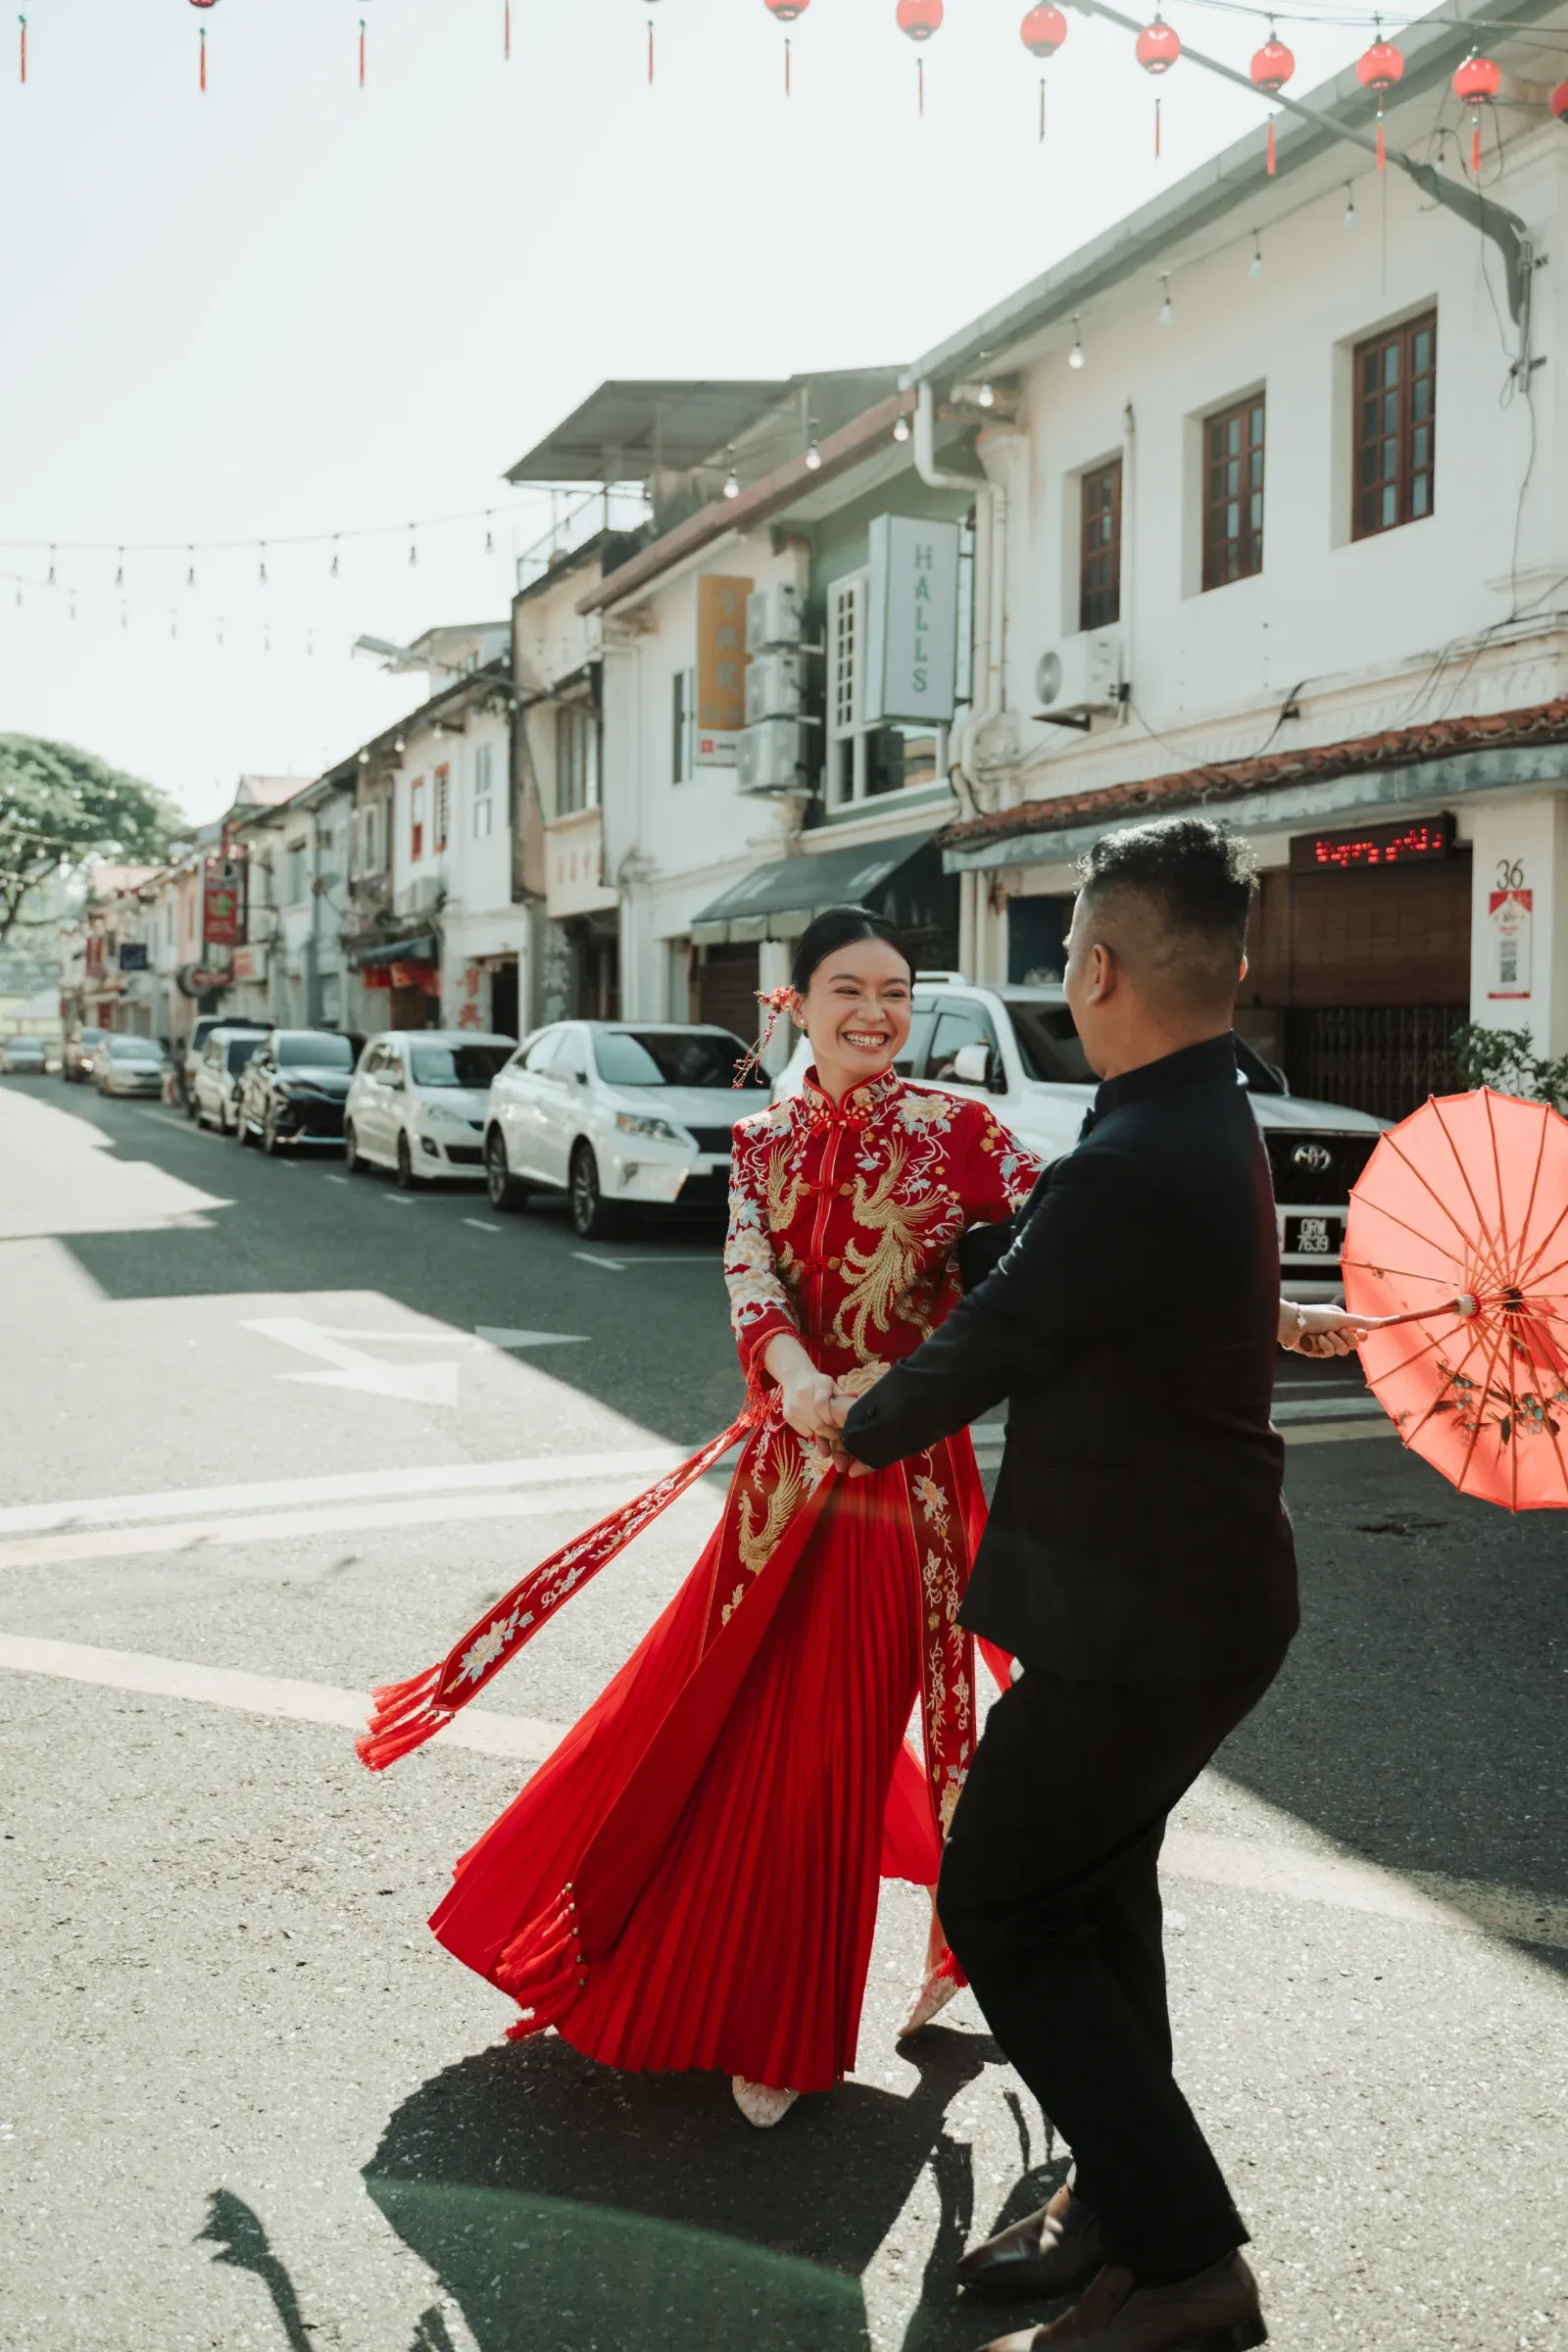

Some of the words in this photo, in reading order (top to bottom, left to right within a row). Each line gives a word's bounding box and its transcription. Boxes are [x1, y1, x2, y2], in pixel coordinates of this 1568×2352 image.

[912, 543, 933, 694] HALLS
[1495, 858, 1524, 891] 36
[1297, 1235, 1329, 1251] 7639
